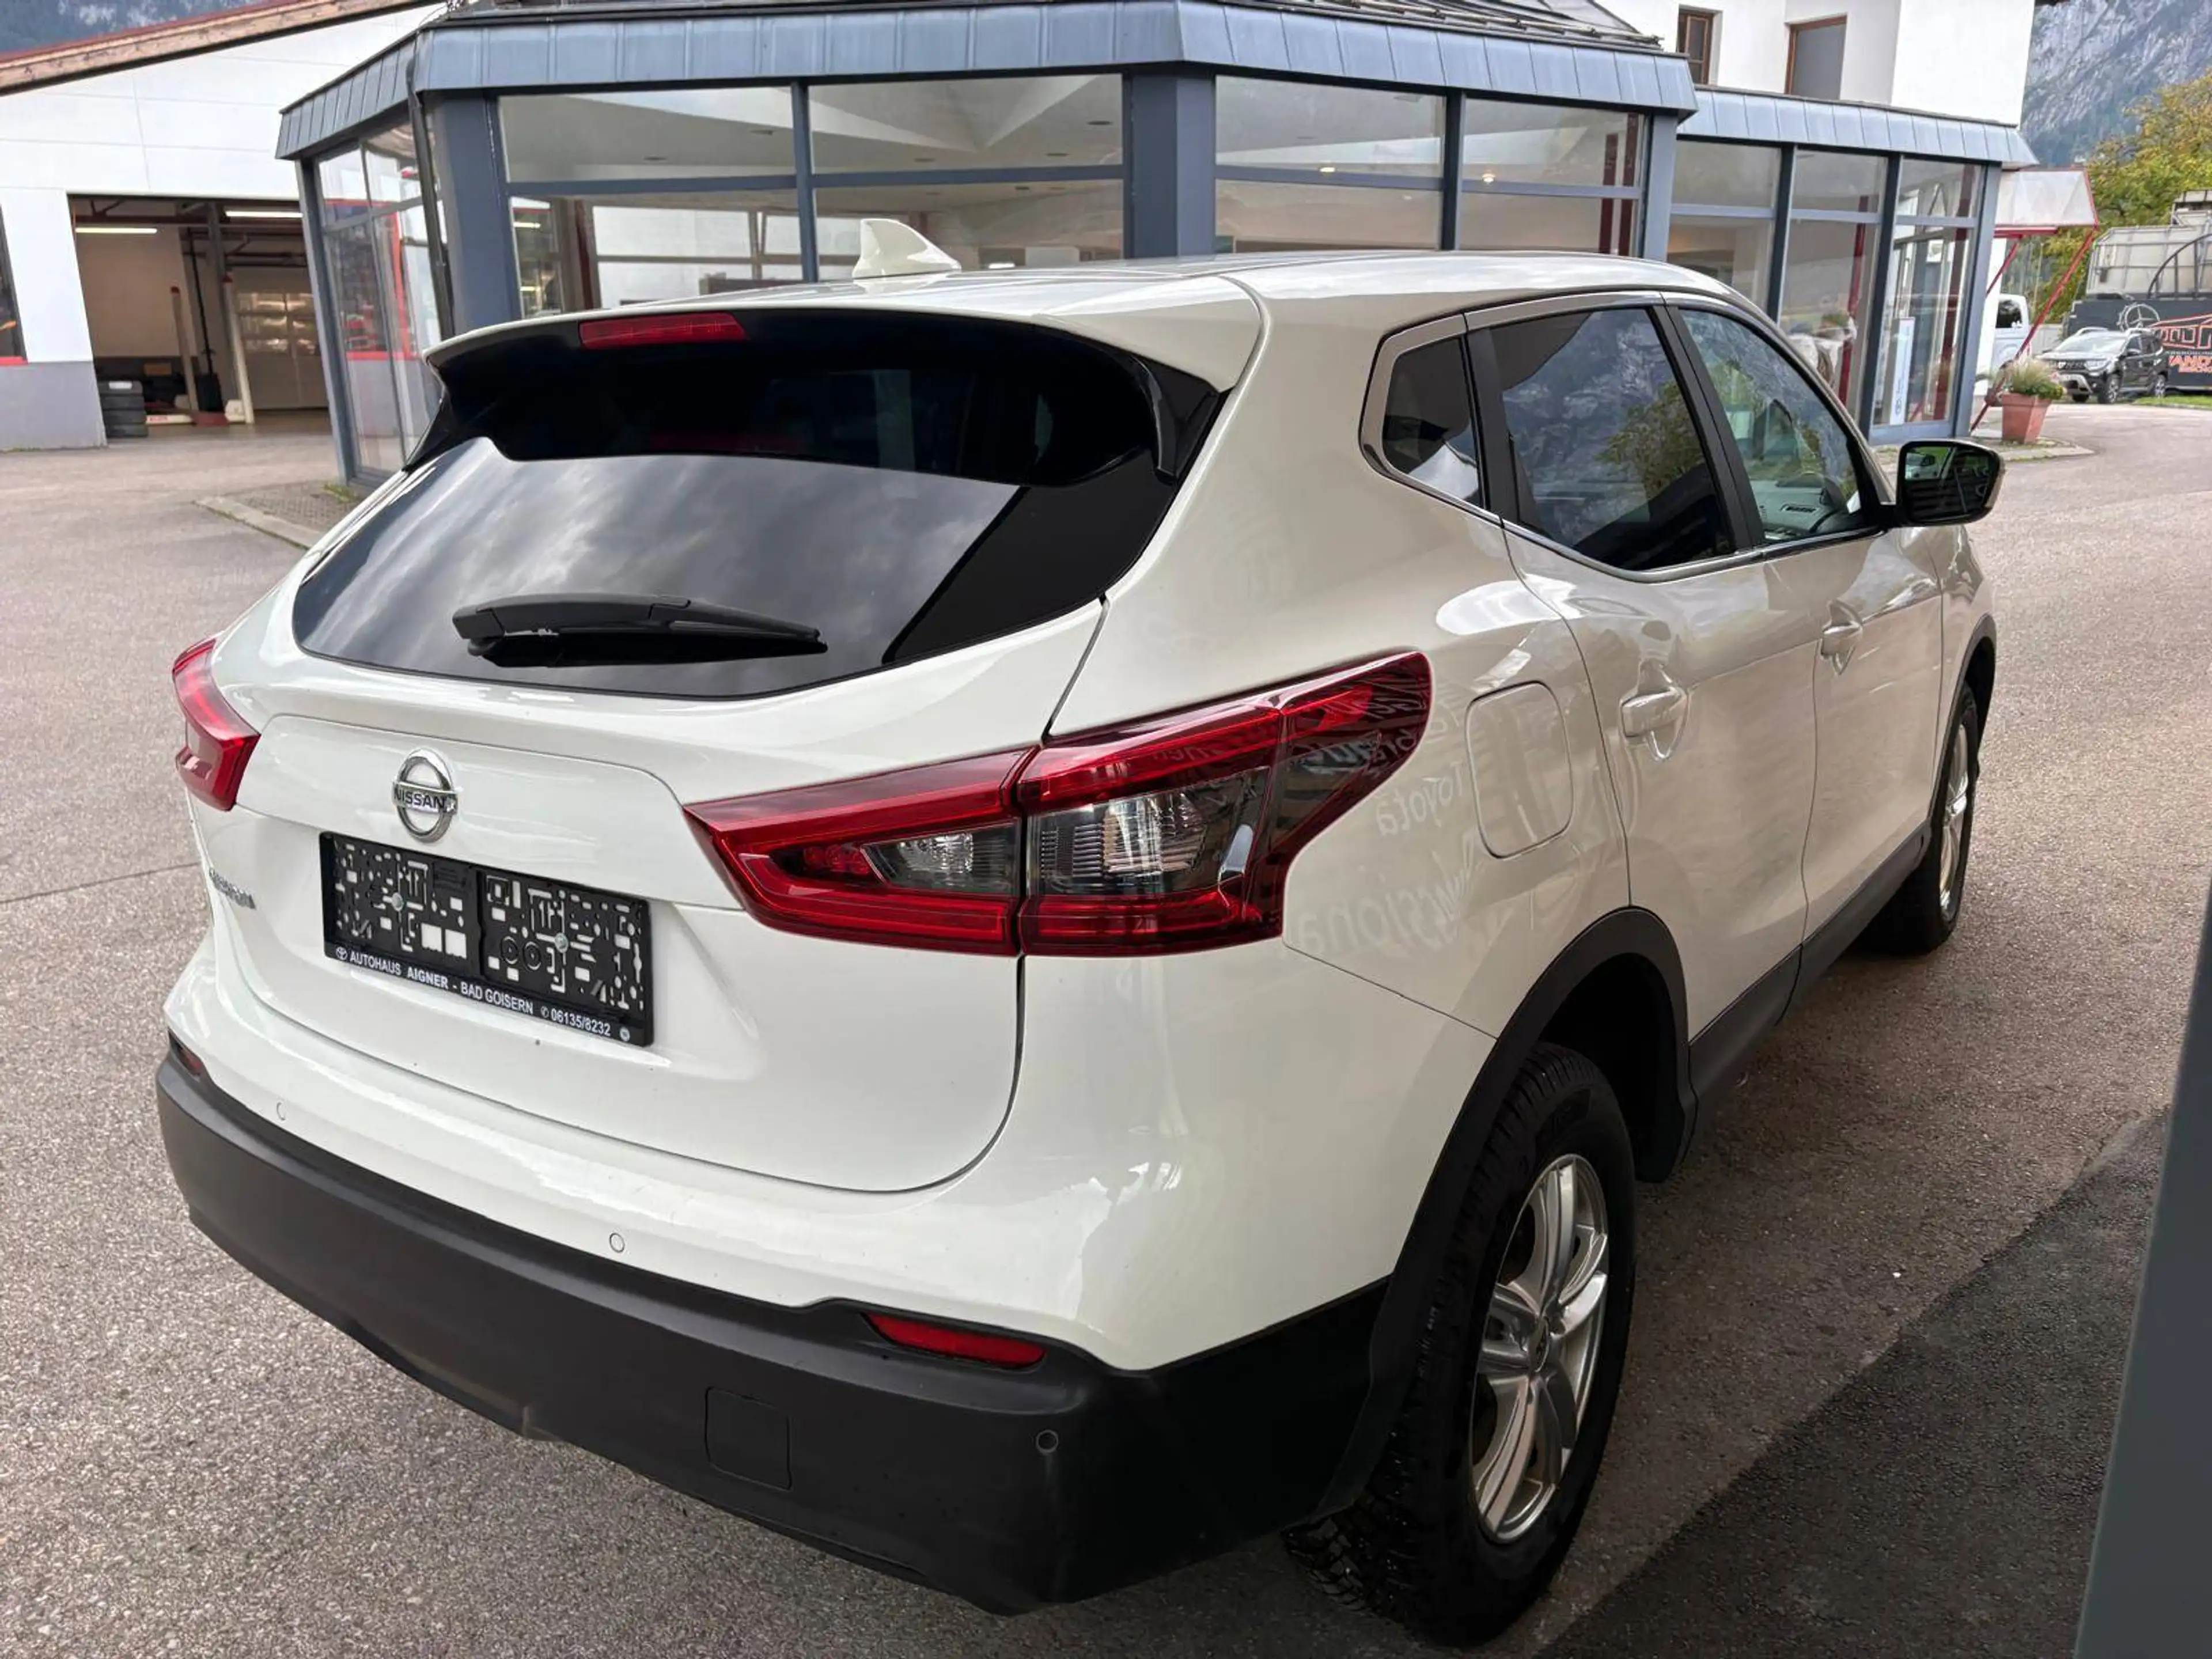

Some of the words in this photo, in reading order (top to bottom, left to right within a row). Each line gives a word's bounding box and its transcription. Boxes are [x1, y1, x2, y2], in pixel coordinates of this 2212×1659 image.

[393, 787, 448, 808] NISSAN
[350, 951, 402, 976] AUTOHAUS
[407, 966, 449, 990] AIGNER
[461, 981, 483, 1000] BAD
[485, 989, 533, 1015] GOISERN
[551, 1008, 611, 1037] 06135/8232
